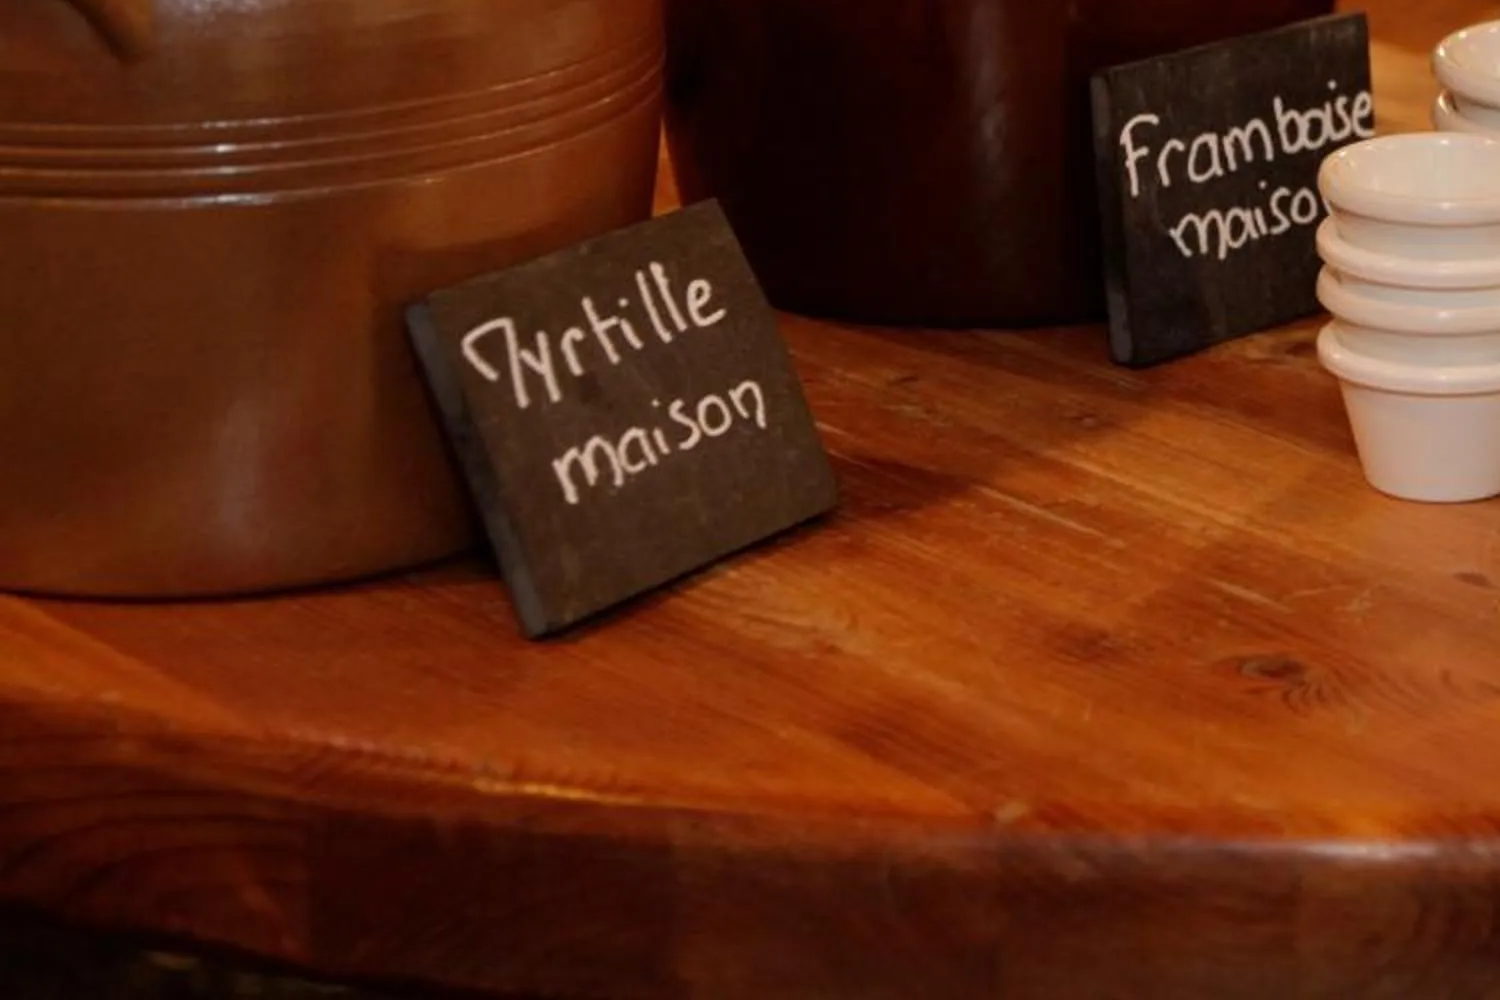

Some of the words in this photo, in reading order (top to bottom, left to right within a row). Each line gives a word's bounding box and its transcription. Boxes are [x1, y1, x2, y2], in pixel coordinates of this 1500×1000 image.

[1119, 79, 1375, 197] Framboise
[1168, 180, 1332, 261] maiso
[461, 261, 727, 409] Myrtille
[551, 379, 767, 505] maison
